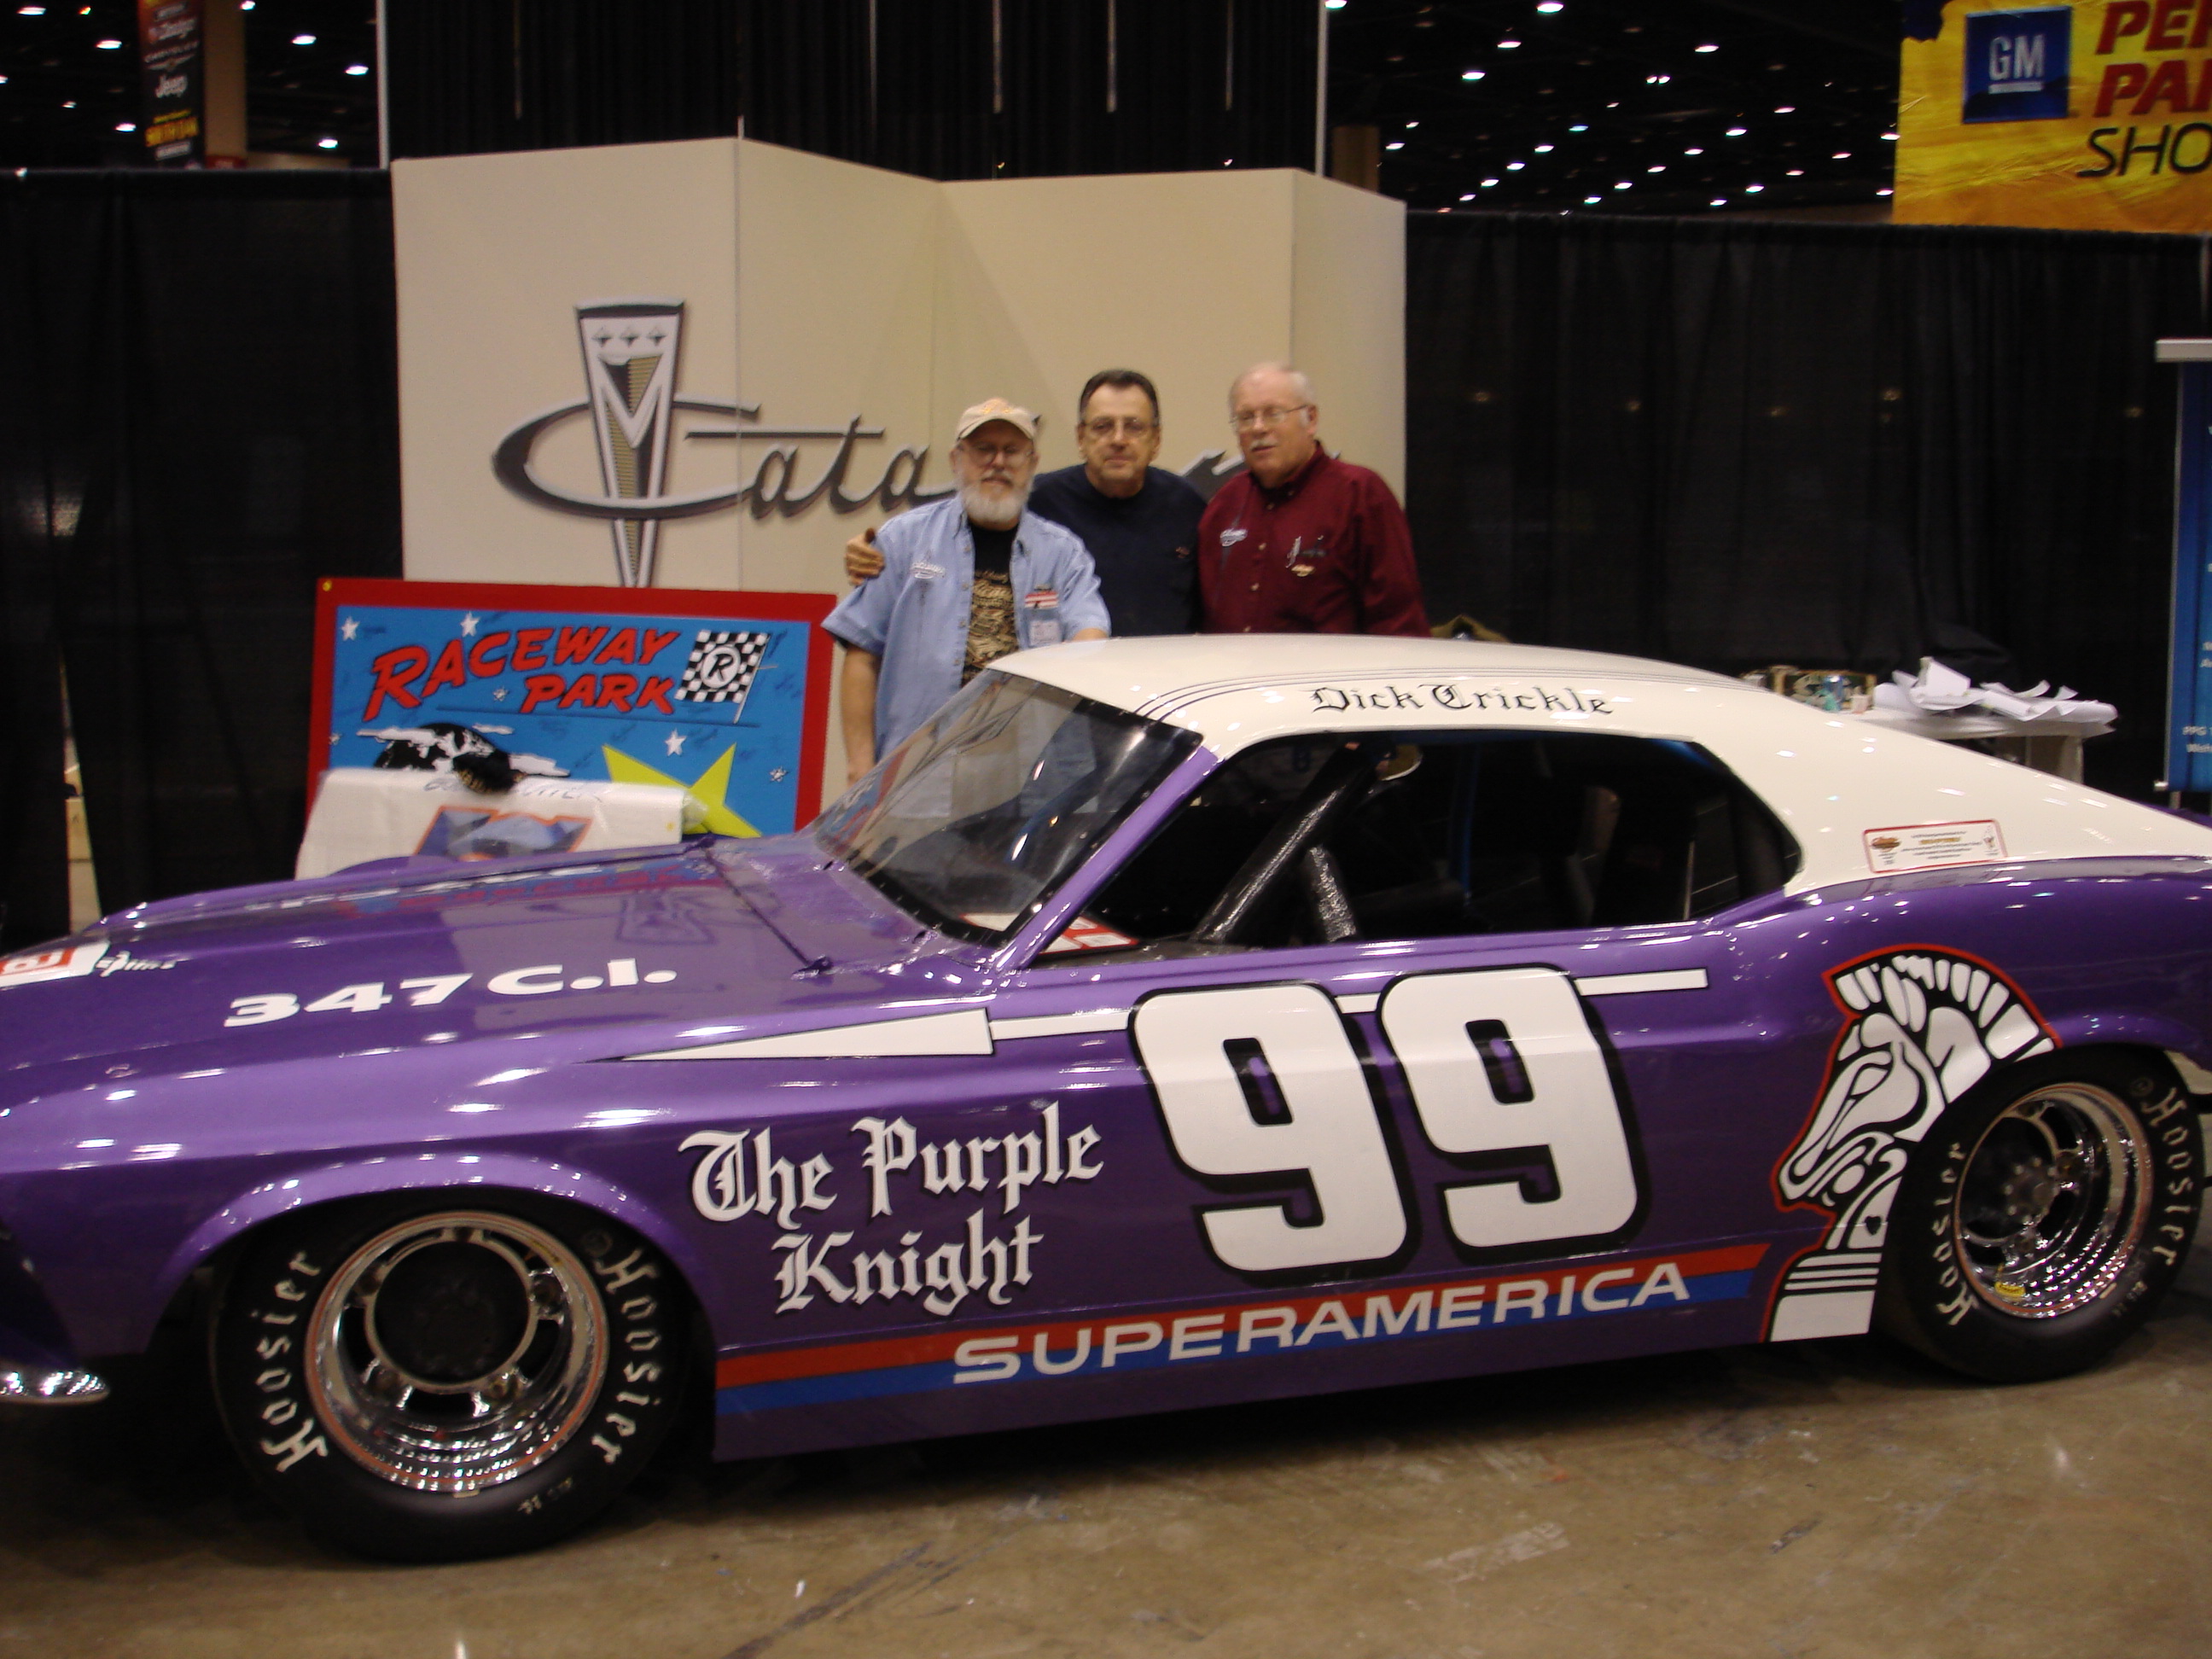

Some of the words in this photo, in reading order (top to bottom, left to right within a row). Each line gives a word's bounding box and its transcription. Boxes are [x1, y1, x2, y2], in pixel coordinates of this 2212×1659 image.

[1988, 34, 2046, 81] GM
[363, 626, 682, 722] RACEWAY
[519, 672, 676, 715] PARK
[707, 651, 736, 684] R
[1302, 684, 1424, 714] Dick
[1418, 684, 1615, 715] Trickle
[224, 972, 474, 1027] 347
[678, 1126, 838, 1231] The
[850, 1099, 1105, 1220] Purple
[1132, 966, 1640, 1274] 99
[771, 1207, 1045, 1317] Knight
[252, 1250, 329, 1473] Hoosier
[591, 1247, 663, 1464] Hoosier
[952, 1261, 1691, 1386] SUPERAMERICA
